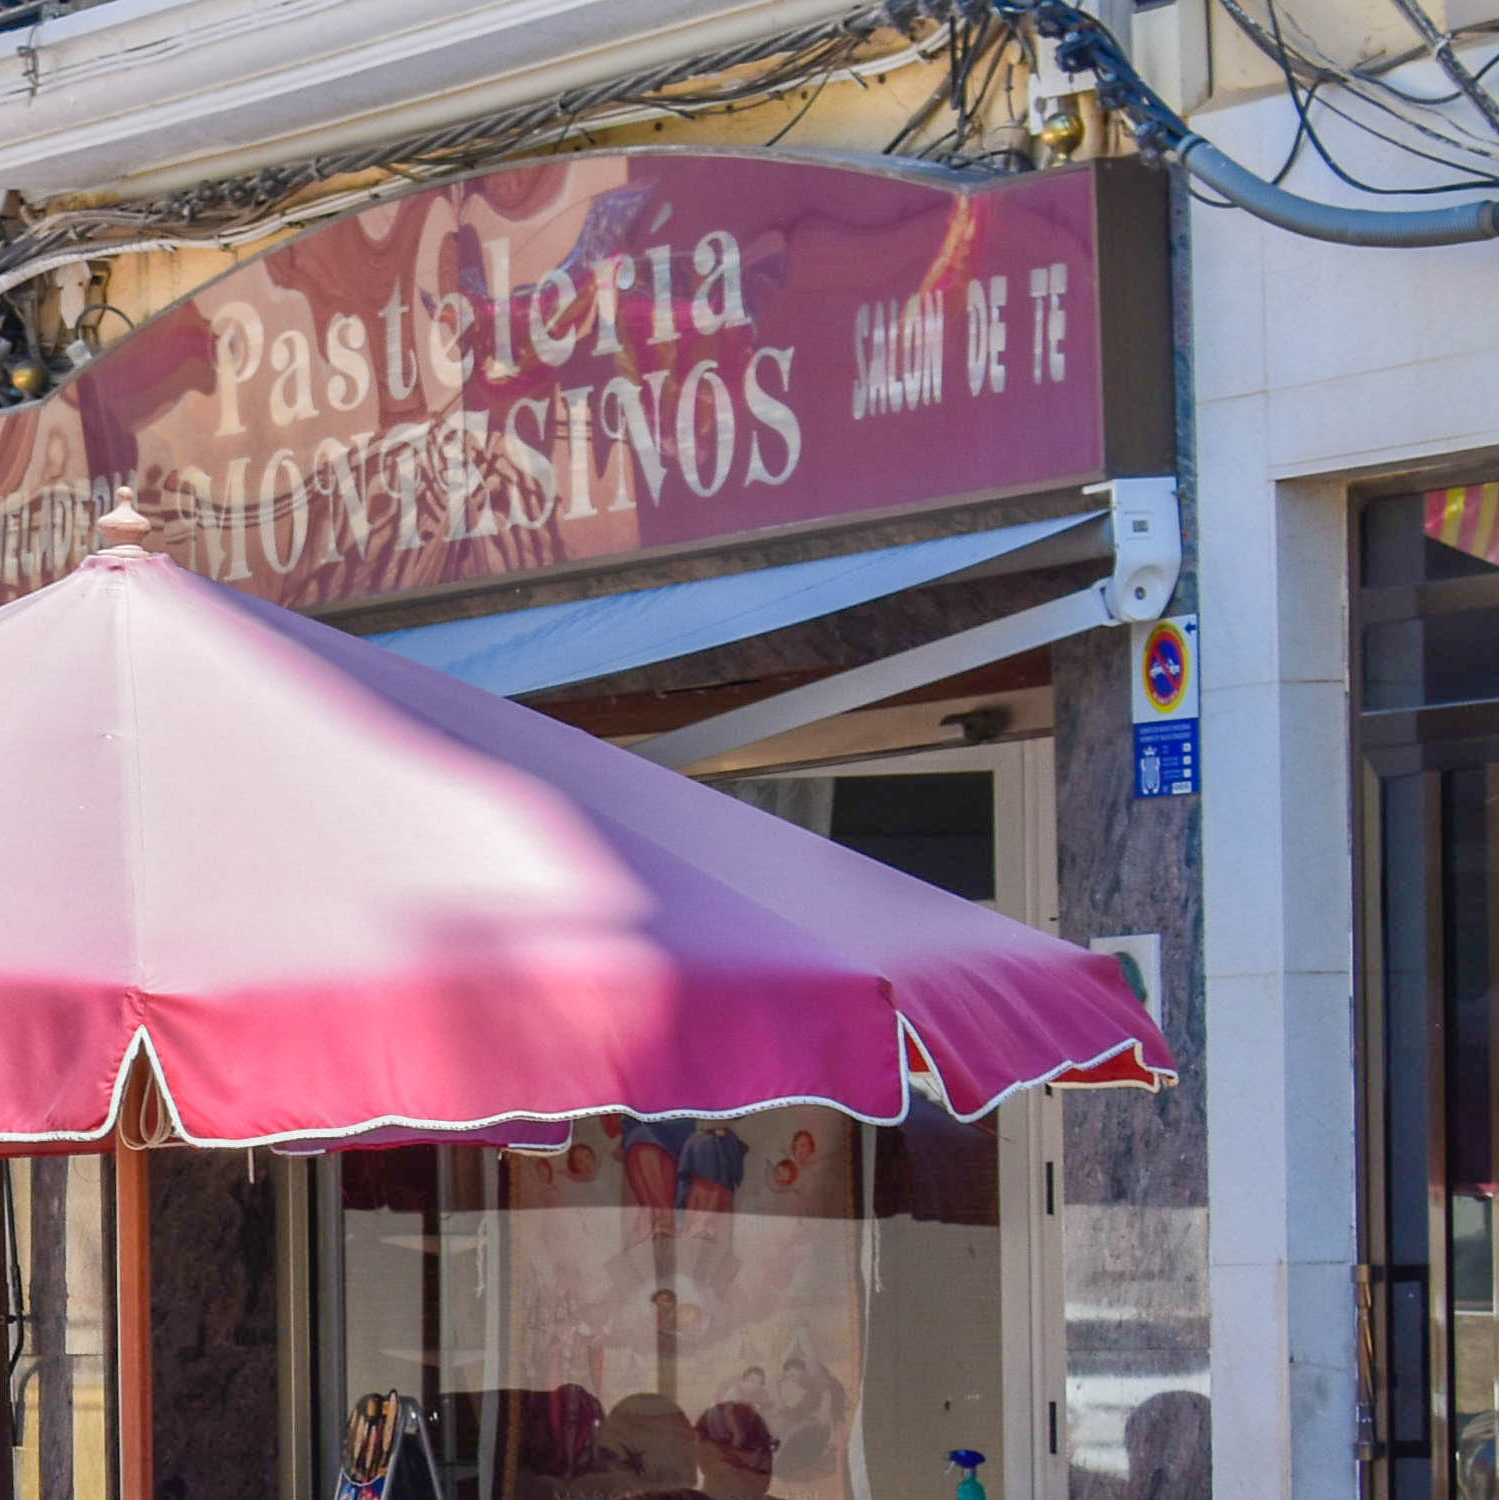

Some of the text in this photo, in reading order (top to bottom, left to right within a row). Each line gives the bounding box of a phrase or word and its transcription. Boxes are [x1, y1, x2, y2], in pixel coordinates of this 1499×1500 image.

[213, 202, 753, 438] Pastelería
[853, 263, 1067, 420] SALON DE TE
[177, 345, 802, 582] MONTESINOS
